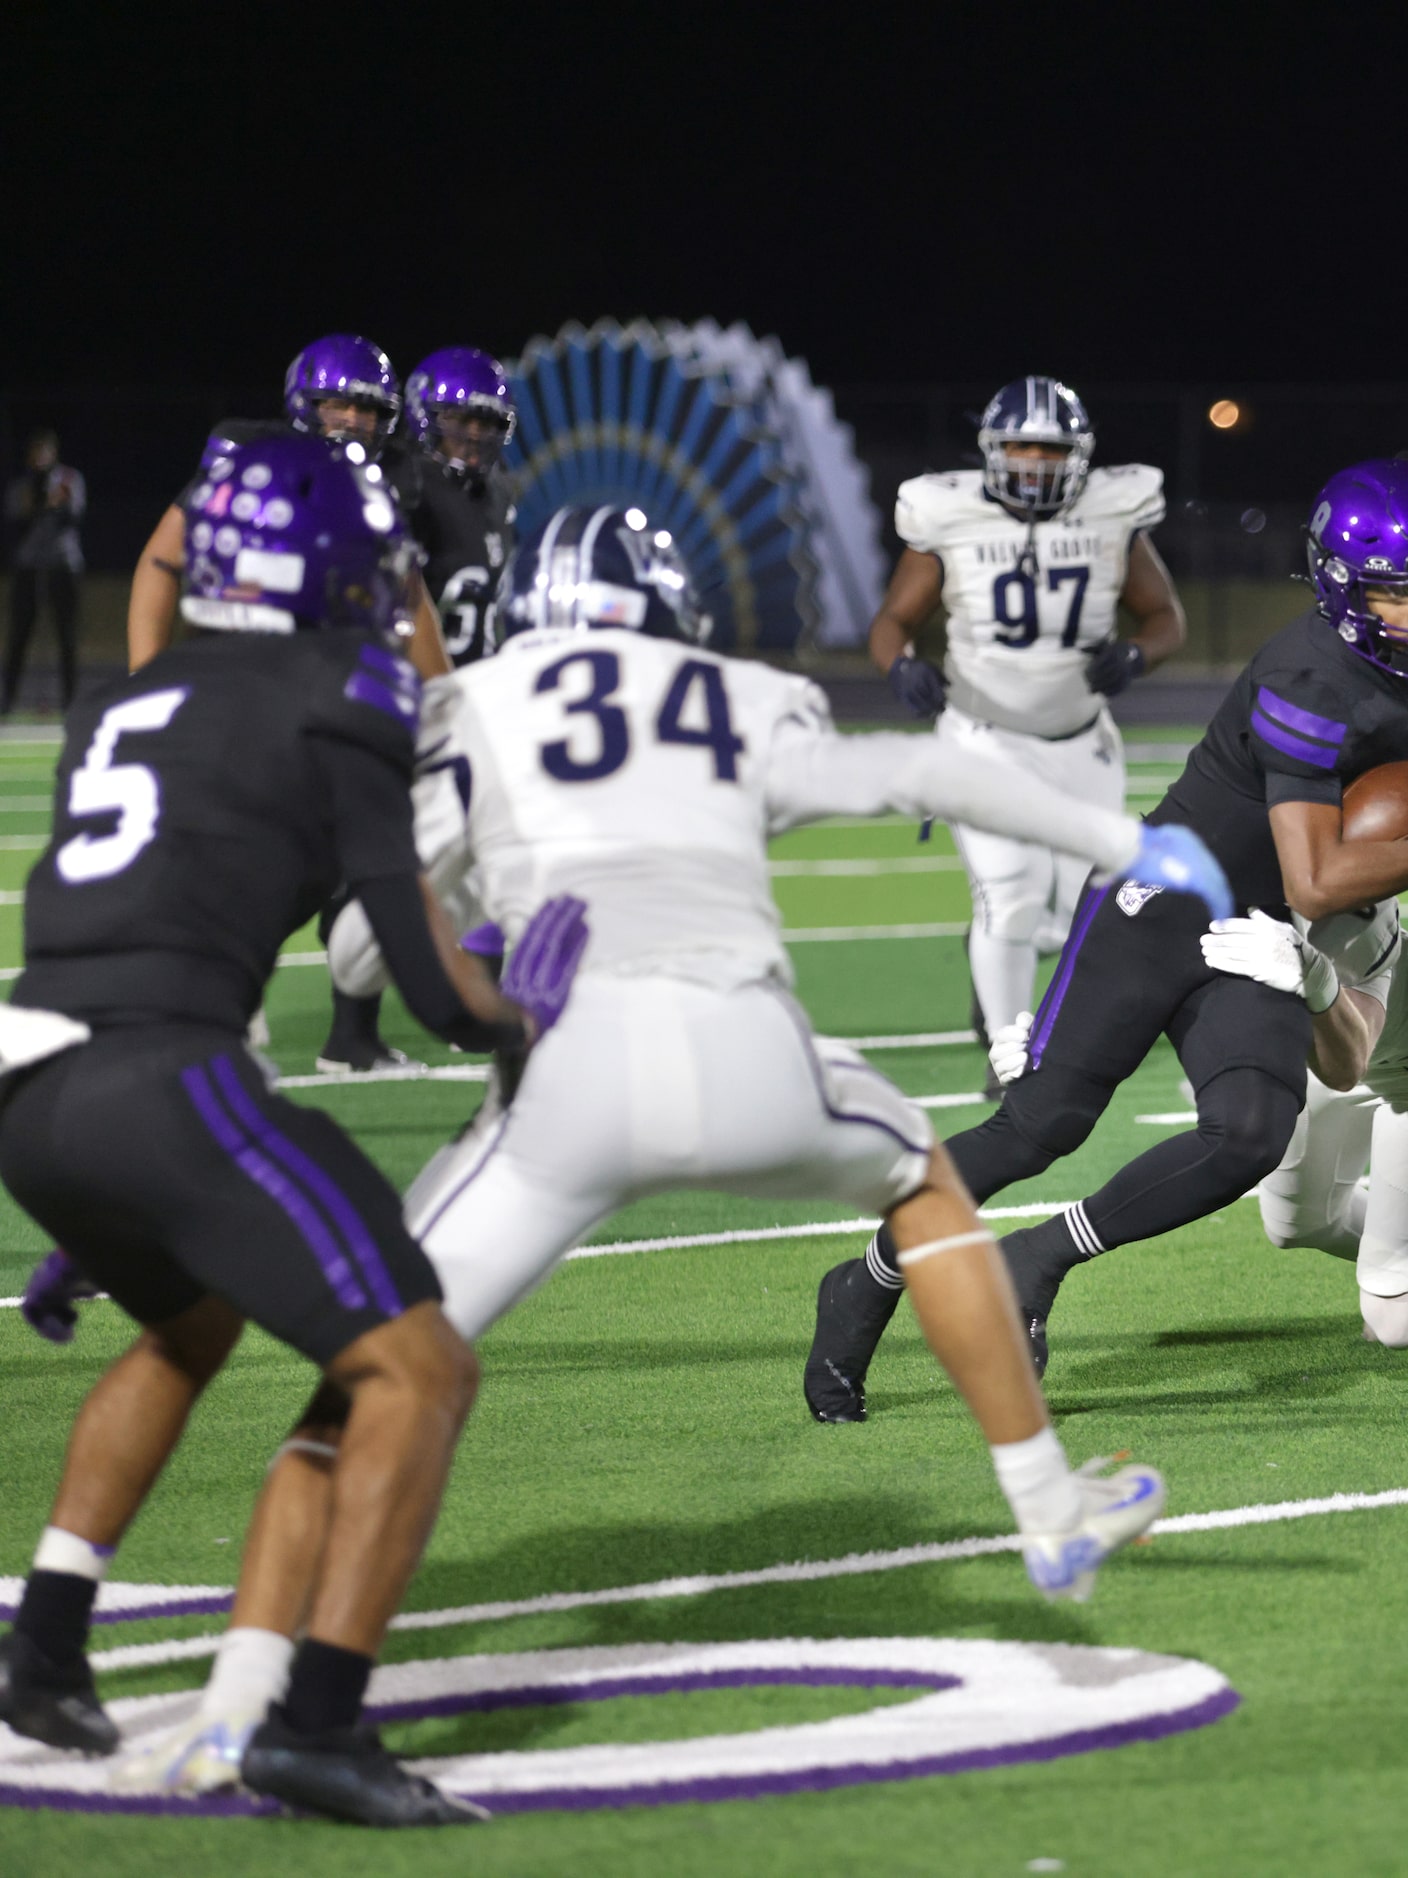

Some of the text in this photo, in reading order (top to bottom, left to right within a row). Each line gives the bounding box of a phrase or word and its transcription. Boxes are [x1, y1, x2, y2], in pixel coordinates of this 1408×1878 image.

[993, 566, 1090, 648] 97
[532, 649, 746, 783] 34
[56, 686, 190, 883] 5
